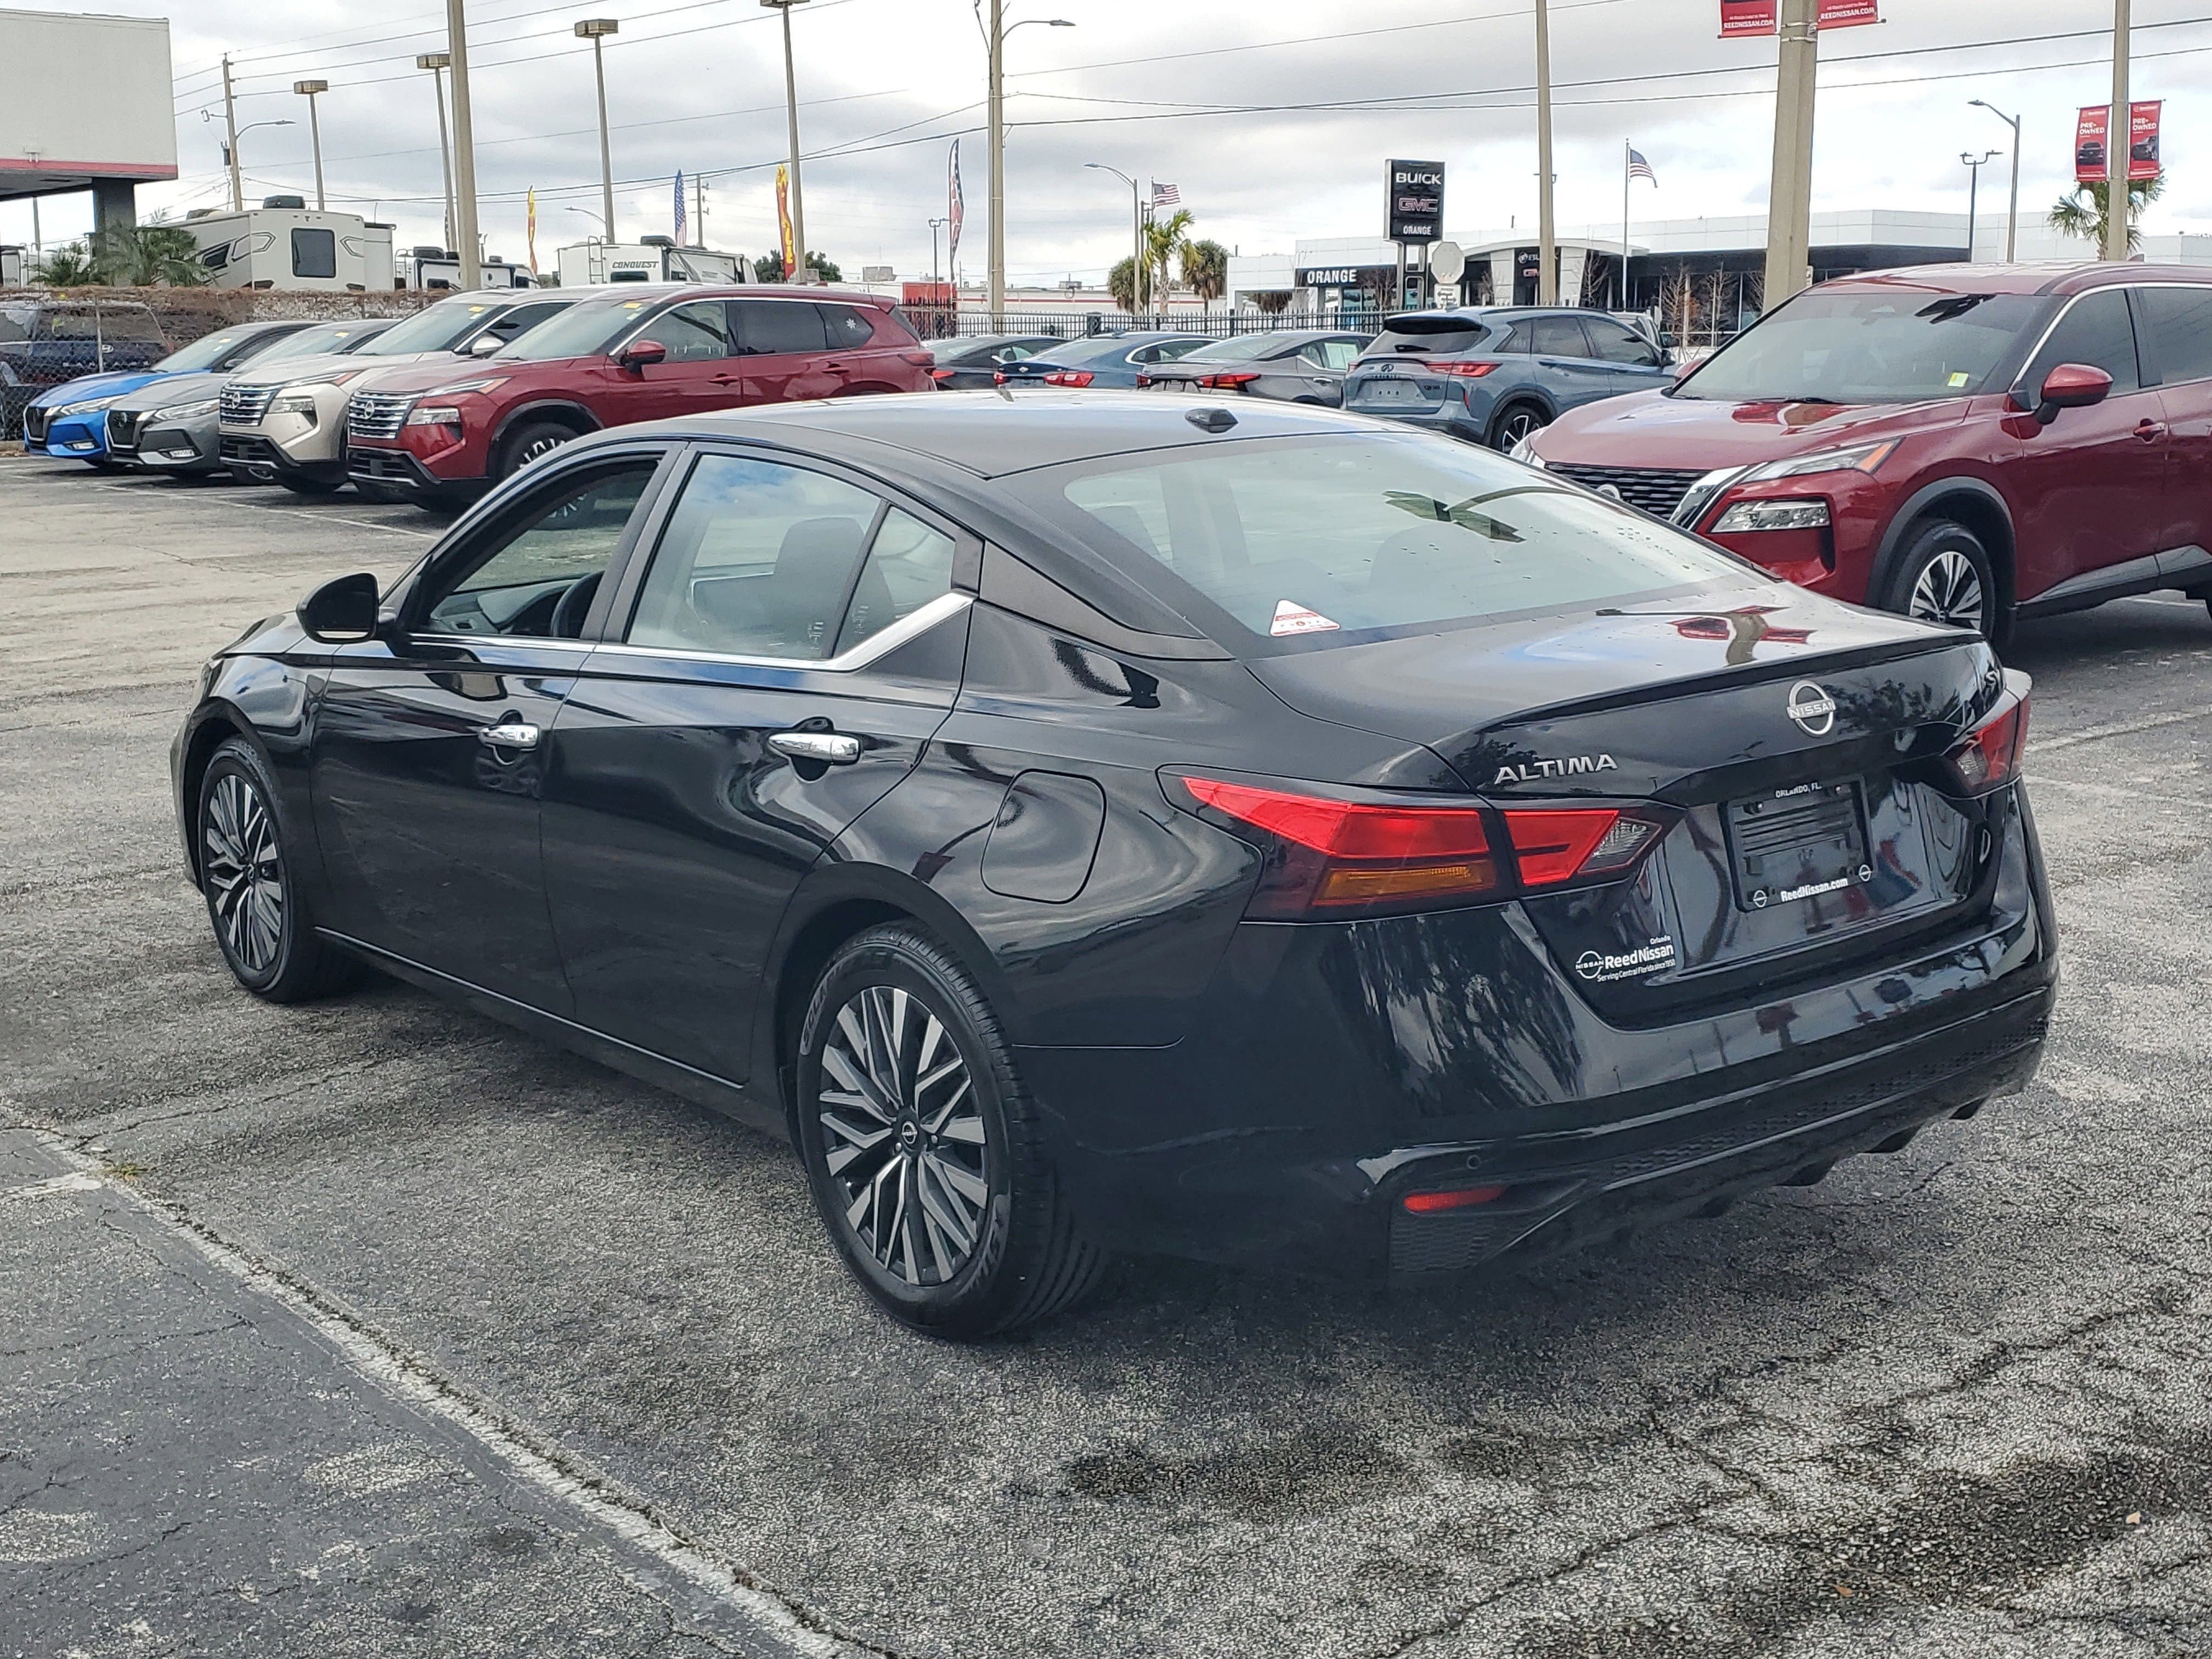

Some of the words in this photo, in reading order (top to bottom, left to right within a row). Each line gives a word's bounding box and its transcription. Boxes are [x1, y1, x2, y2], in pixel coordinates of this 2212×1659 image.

[1396, 172, 1442, 184] BUICK
[1398, 198, 1438, 212] GMC
[1403, 225, 1432, 235] ORANGE
[1307, 269, 1357, 284] ORANGE
[1789, 702, 1835, 716] NISSAN
[1494, 754, 1618, 785] ALTIMA
[1781, 878, 1848, 902] ReedNissan.com
[1576, 960, 1604, 969] NISSAN
[1597, 972, 1620, 982] Serving
[1619, 968, 1638, 978] Central
[1638, 963, 1655, 975] Florida
